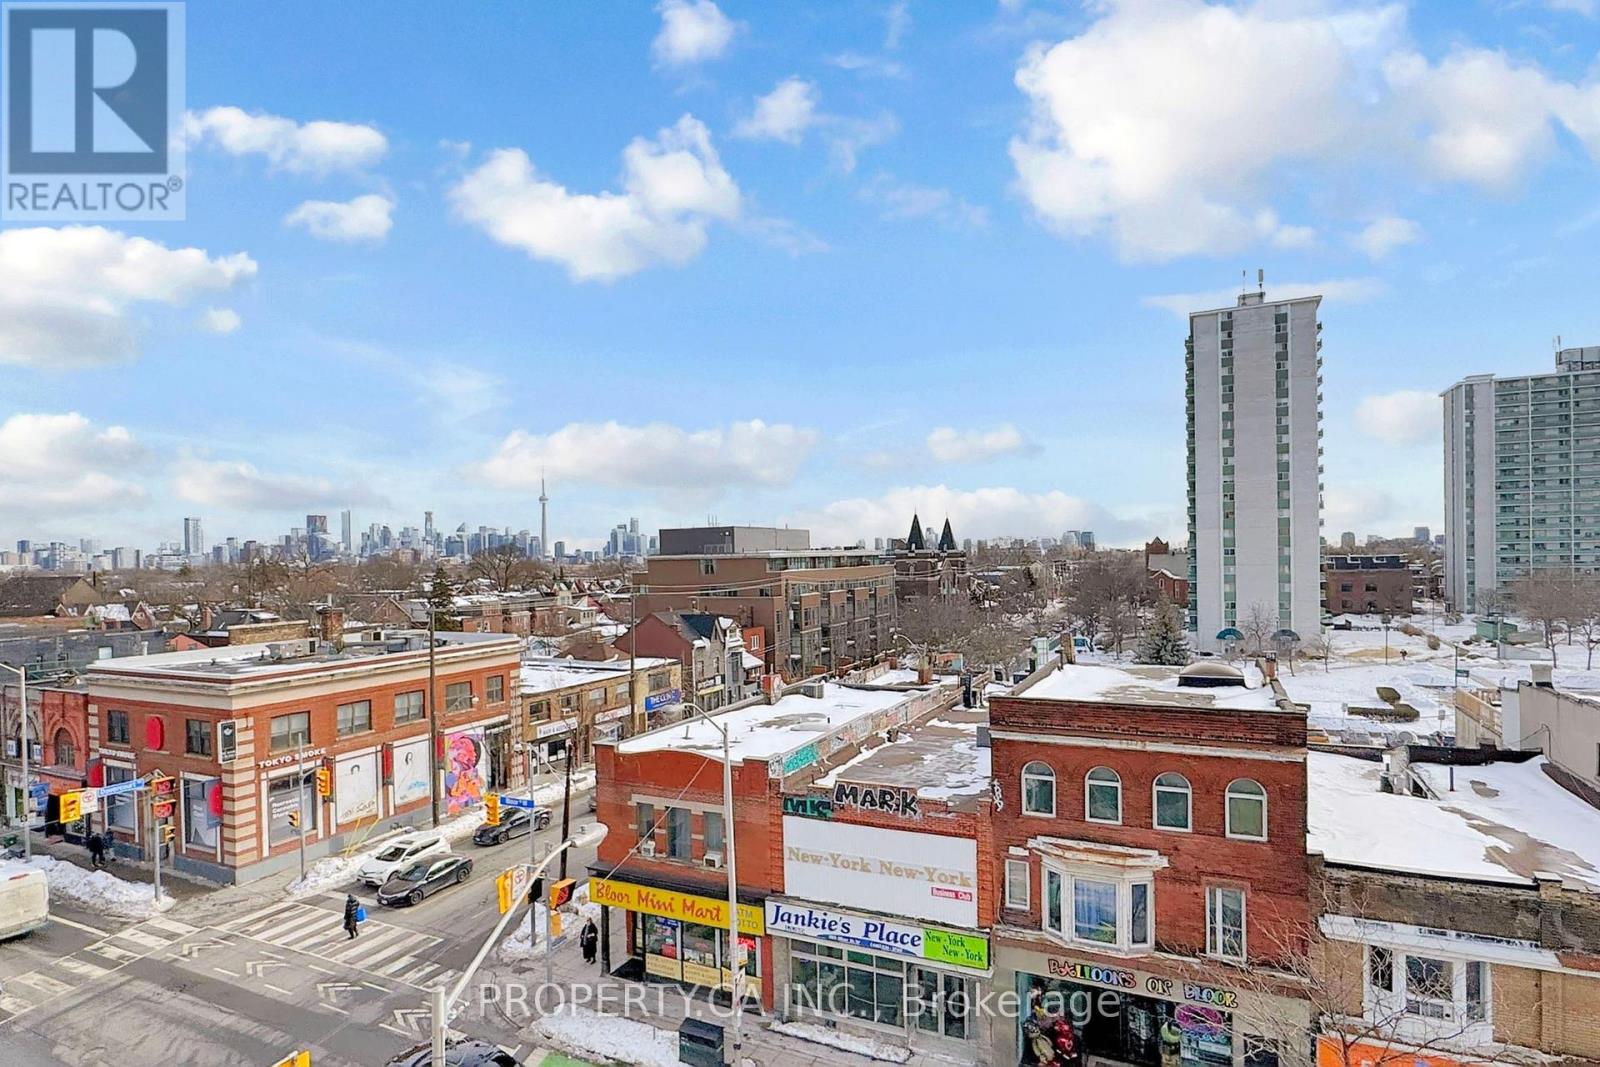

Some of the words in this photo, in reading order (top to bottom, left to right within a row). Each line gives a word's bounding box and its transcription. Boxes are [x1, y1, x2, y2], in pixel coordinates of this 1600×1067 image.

[258, 755, 292, 769] TOKYO
[295, 748, 326, 761] SMOKE
[788, 847, 872, 873] New-York
[879, 860, 973, 888] New-York
[595, 882, 631, 904] Bloor
[637, 889, 675, 913] Mini
[682, 898, 723, 922] Mart
[770, 904, 851, 934] Jankie's
[863, 921, 922, 947] Place
[1145, 976, 1173, 996] ON
[1183, 981, 1238, 1009] BLOOR
